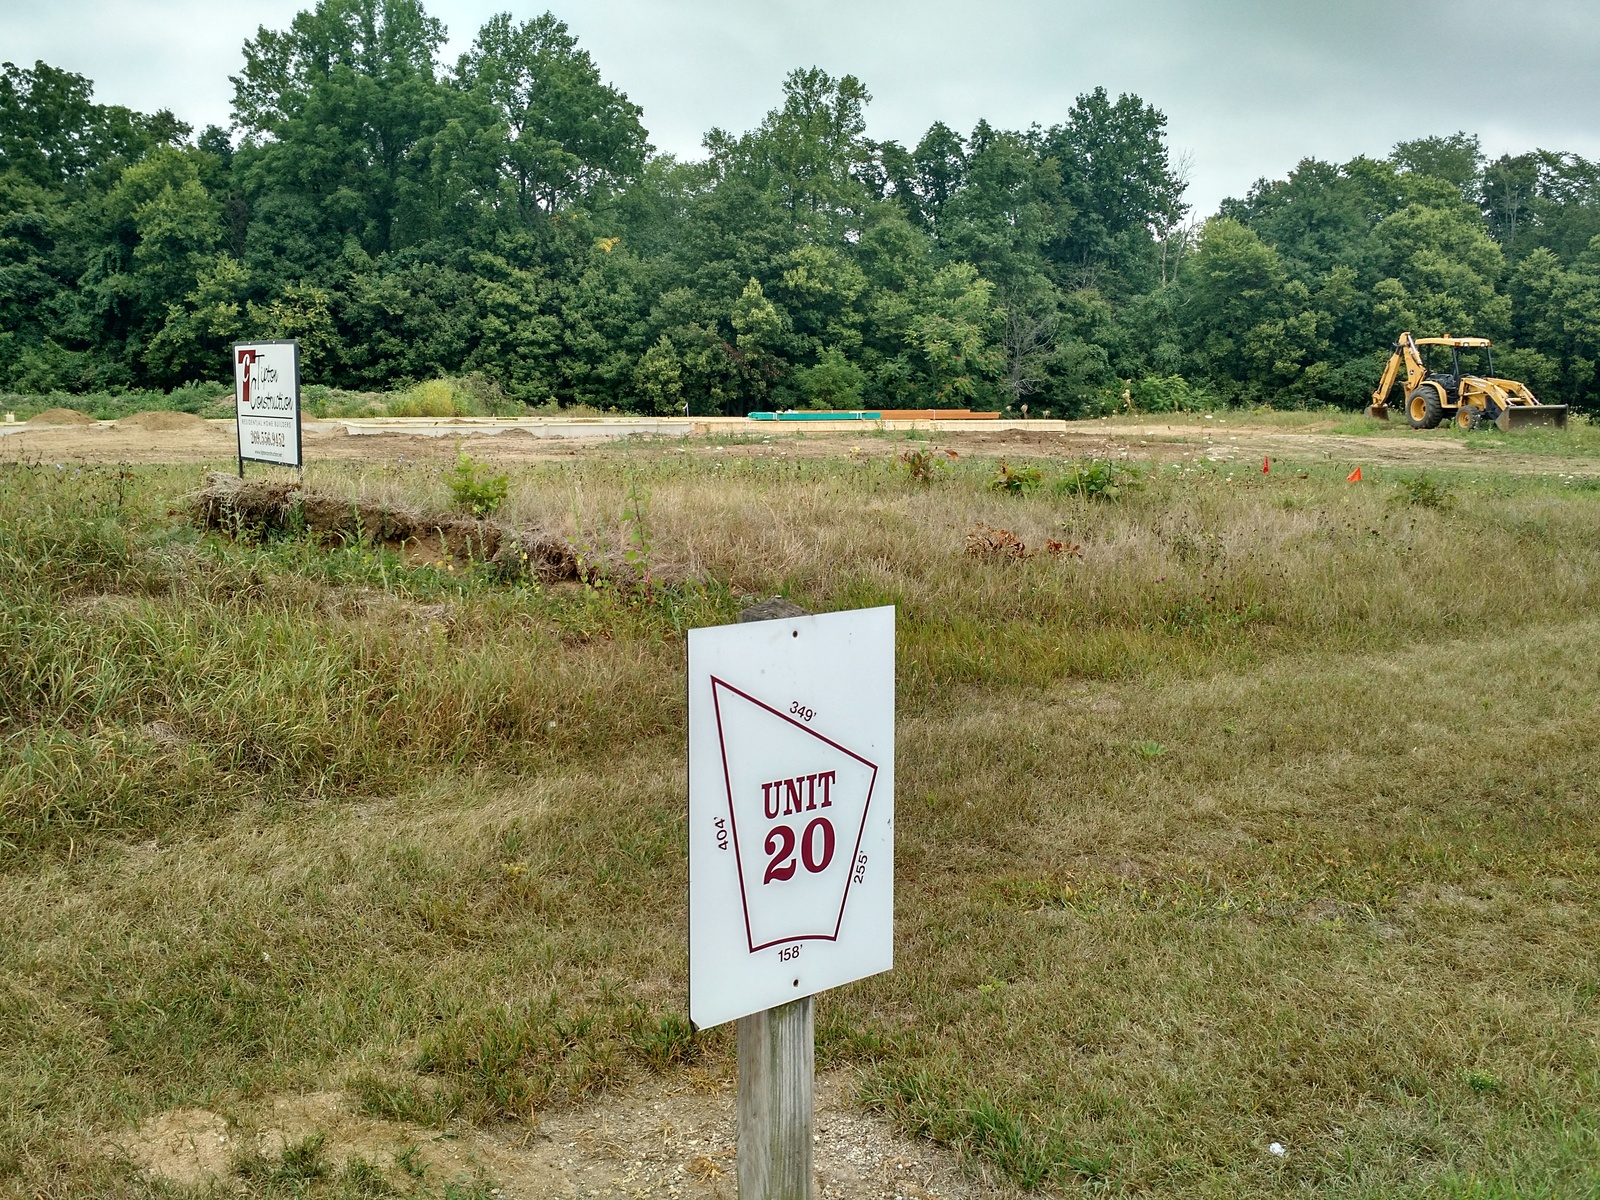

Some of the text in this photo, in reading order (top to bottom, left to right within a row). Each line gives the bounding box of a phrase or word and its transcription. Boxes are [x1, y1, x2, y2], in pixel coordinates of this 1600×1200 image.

[250, 377, 293, 410] Construction
[789, 700, 817, 723] 349'
[762, 770, 836, 820] UNIT
[714, 816, 729, 851] 404'
[764, 816, 836, 886] 20
[853, 850, 869, 885] 255'
[777, 944, 804, 963] 158'
